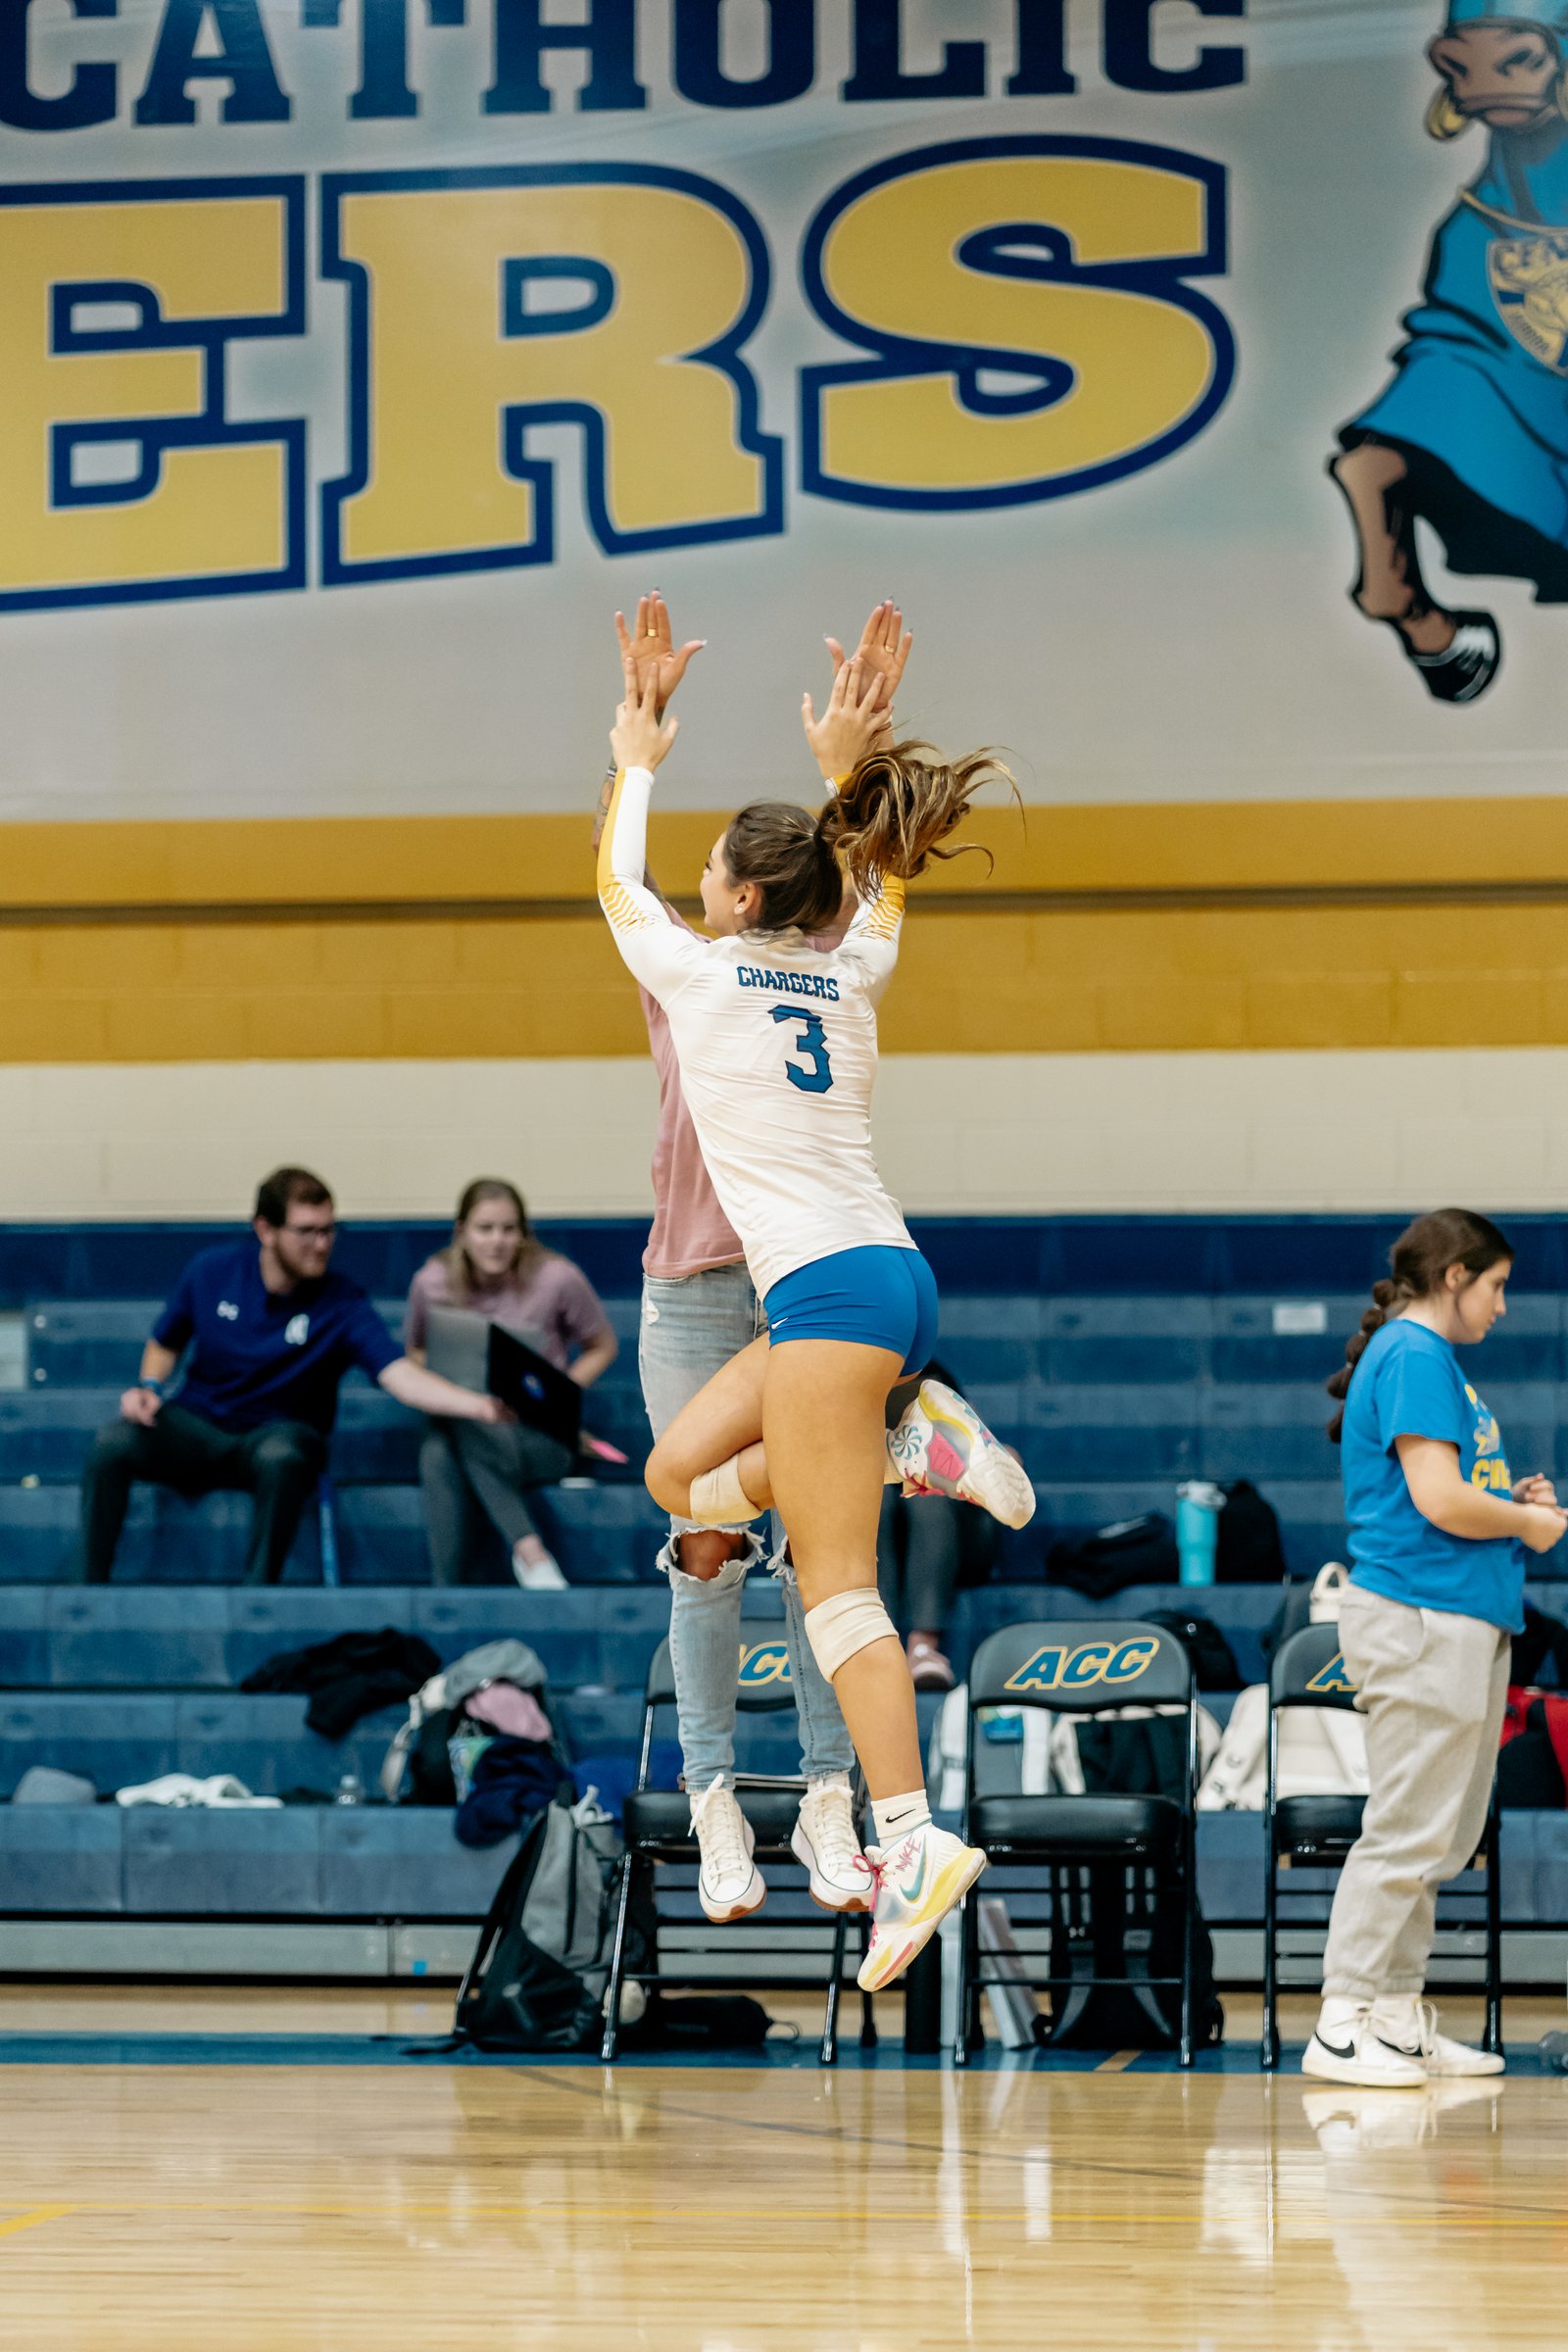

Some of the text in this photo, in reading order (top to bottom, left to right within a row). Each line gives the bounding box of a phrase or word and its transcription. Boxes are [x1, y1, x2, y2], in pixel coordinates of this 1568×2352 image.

[0, 0, 1246, 131] CATHOLIC
[0, 134, 1238, 613] ERS
[737, 966, 840, 1002] CHARGERS
[767, 1004, 834, 1094] 3
[1004, 1637, 1160, 1690] ACC
